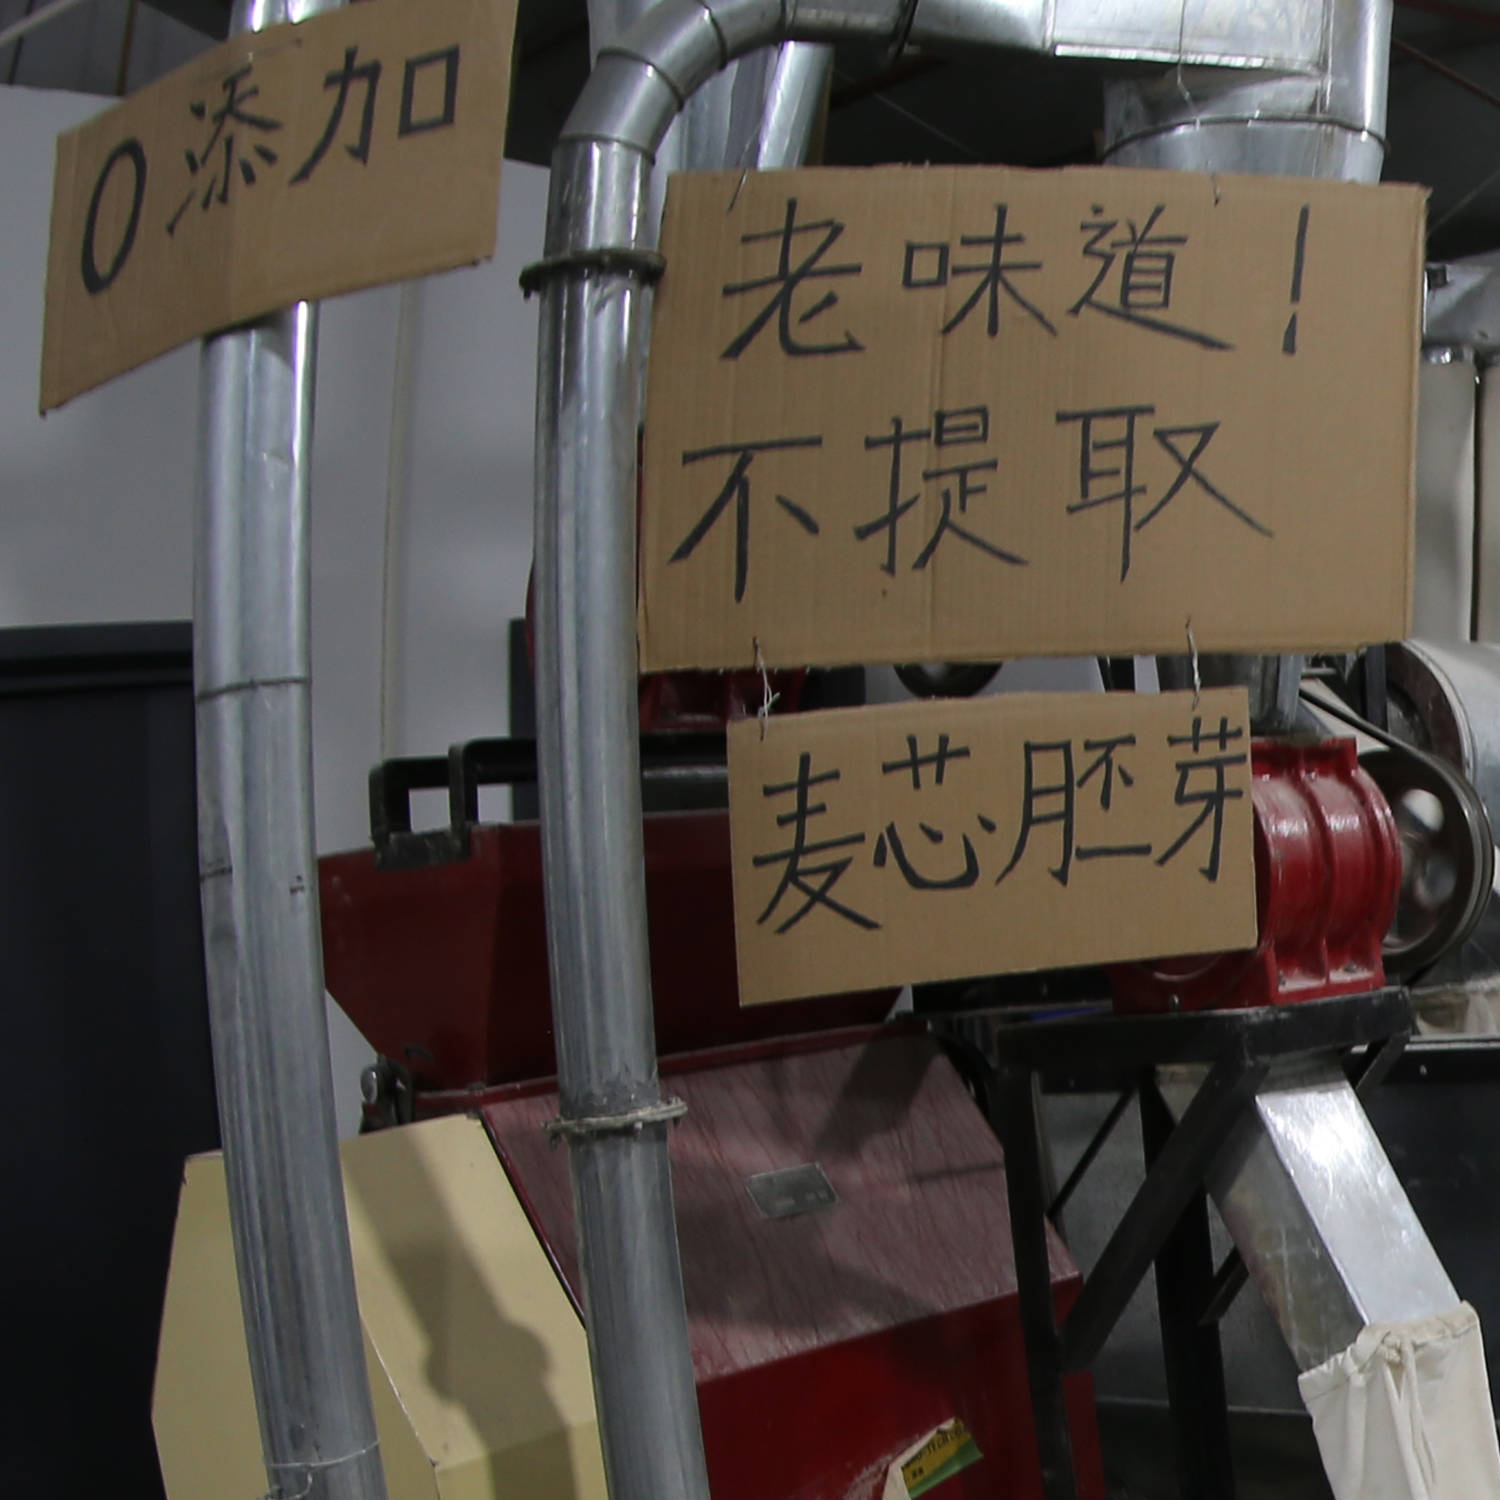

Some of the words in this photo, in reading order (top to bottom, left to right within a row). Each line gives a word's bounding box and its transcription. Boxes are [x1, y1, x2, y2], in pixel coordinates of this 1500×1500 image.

[79, 46, 458, 295] 0添加
[667, 403, 1275, 604] 不提取
[752, 716, 1246, 935] 麦芯胚芽
